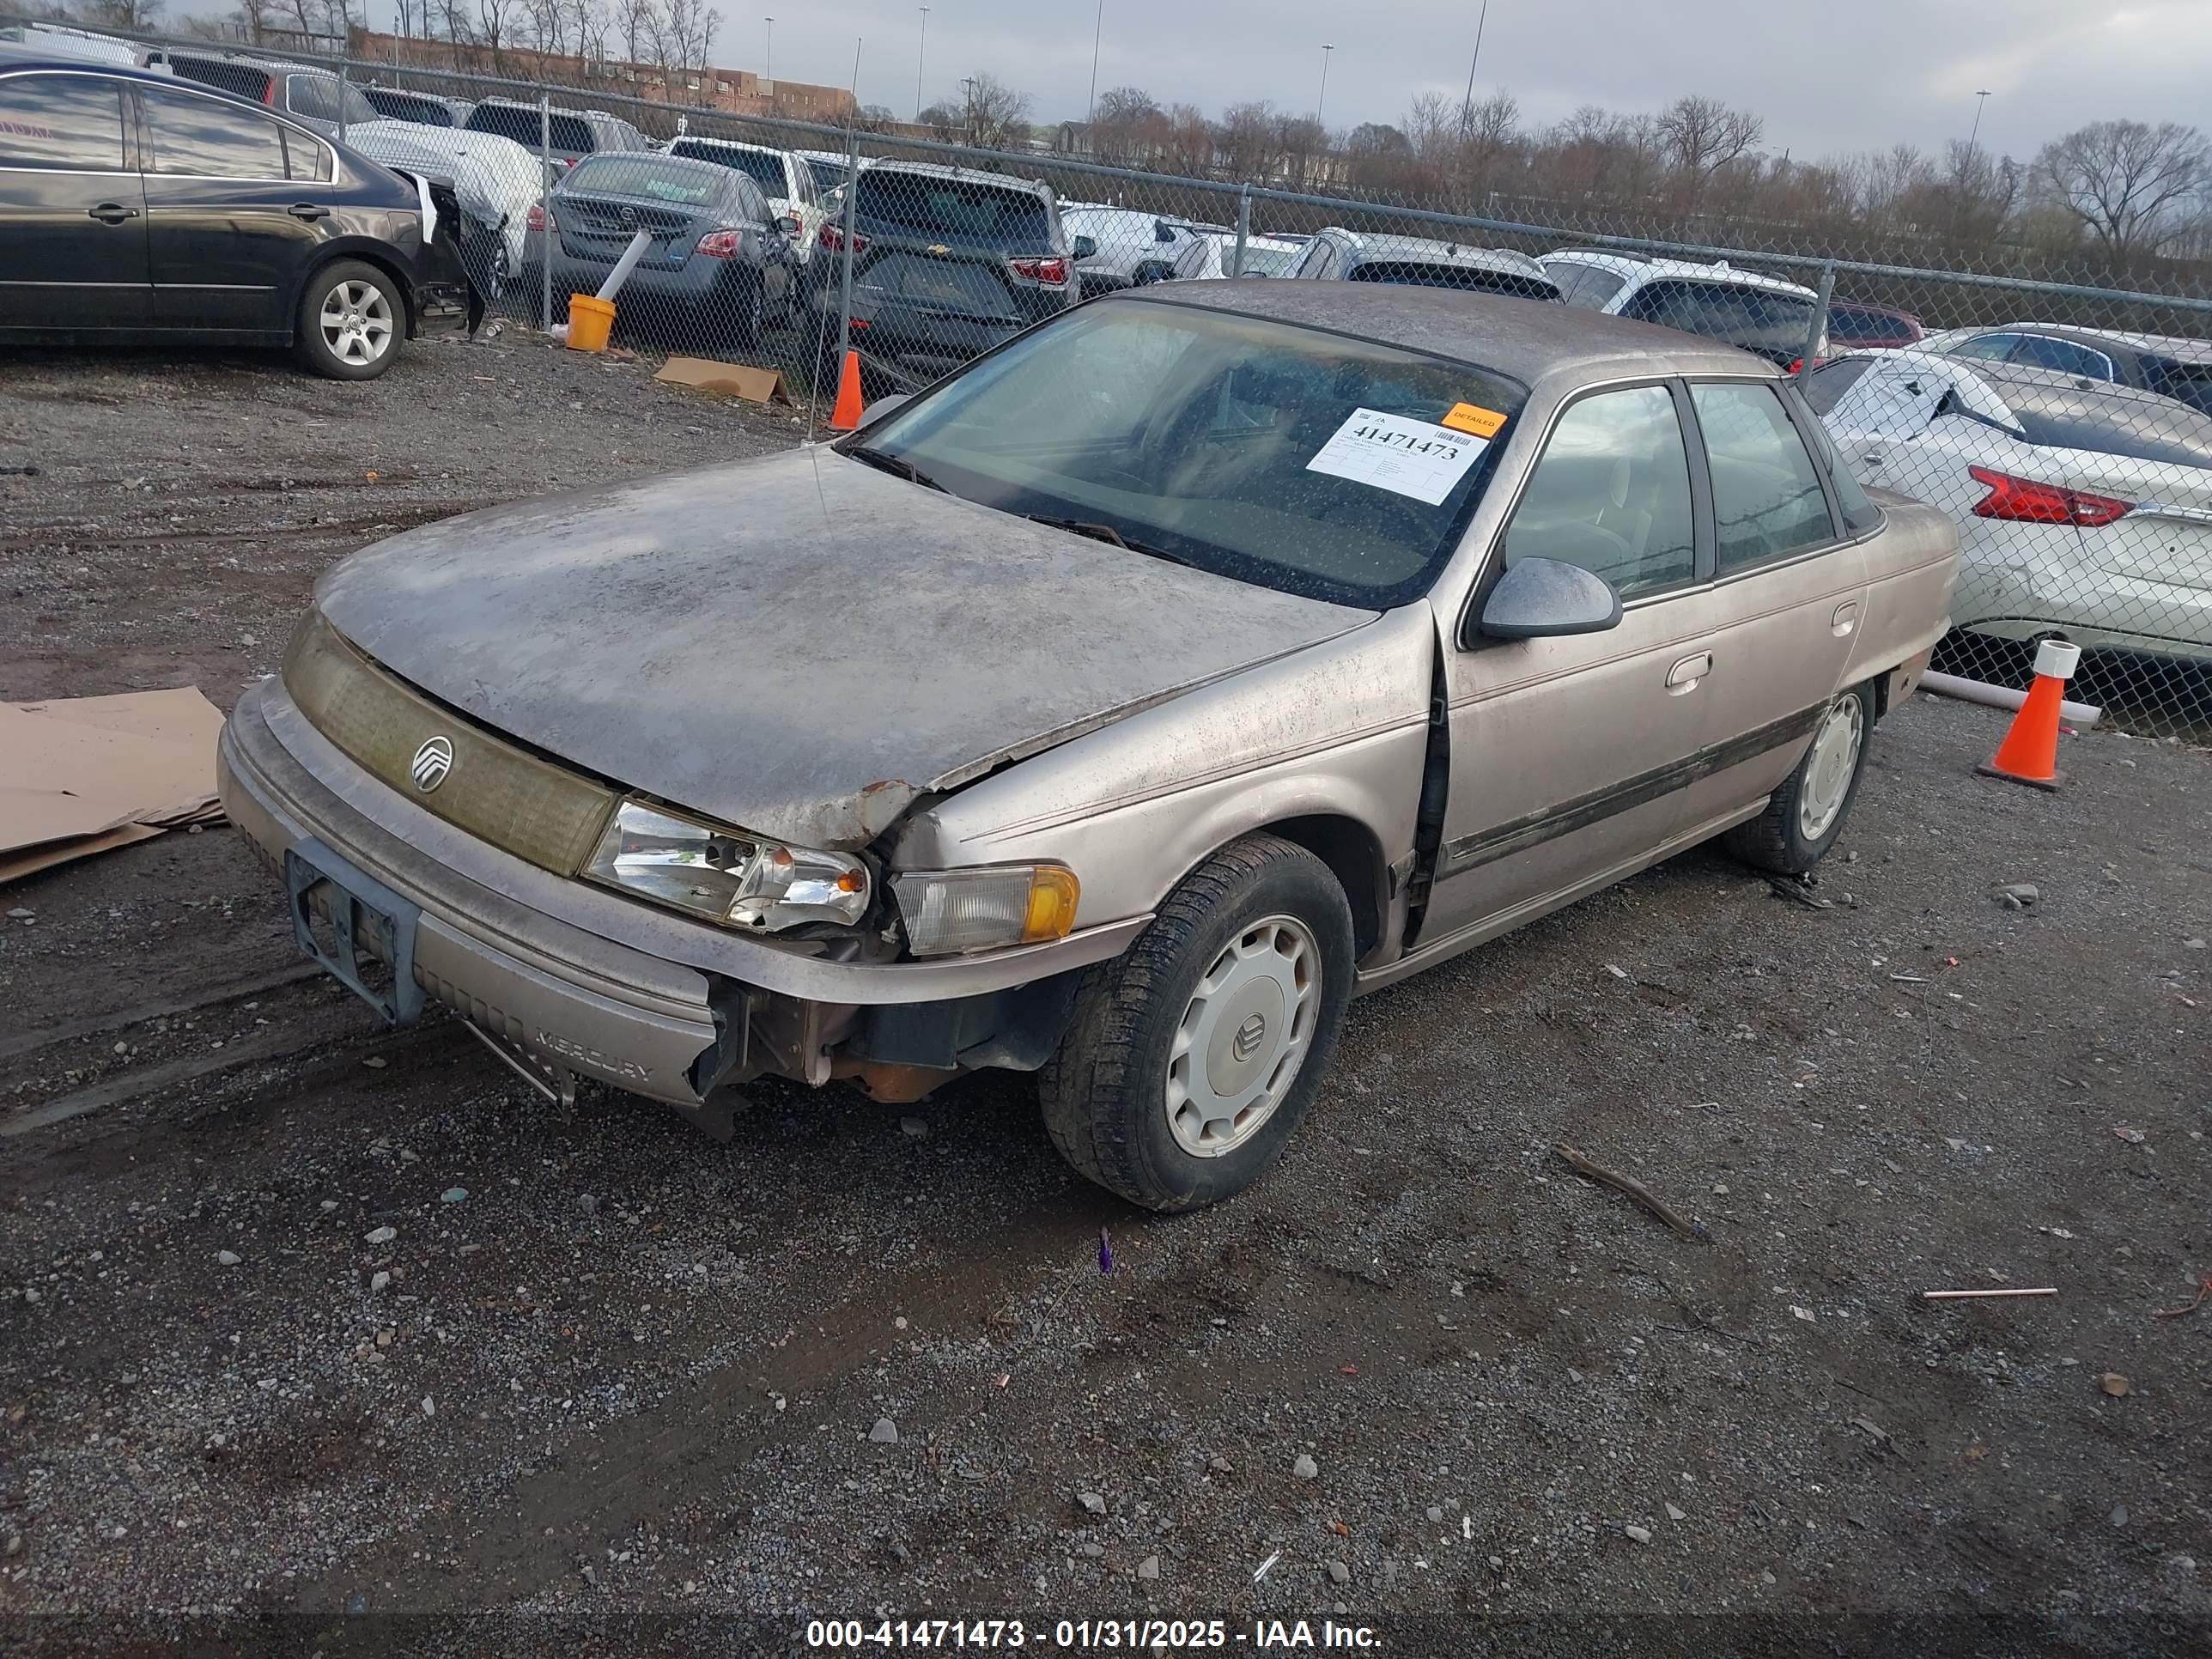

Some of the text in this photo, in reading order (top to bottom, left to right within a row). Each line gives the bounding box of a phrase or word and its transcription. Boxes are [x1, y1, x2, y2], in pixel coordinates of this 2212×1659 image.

[1454, 412, 1495, 427] DETAILED
[1353, 426, 1458, 460] 41471473
[536, 1030, 653, 1081] MERCURY
